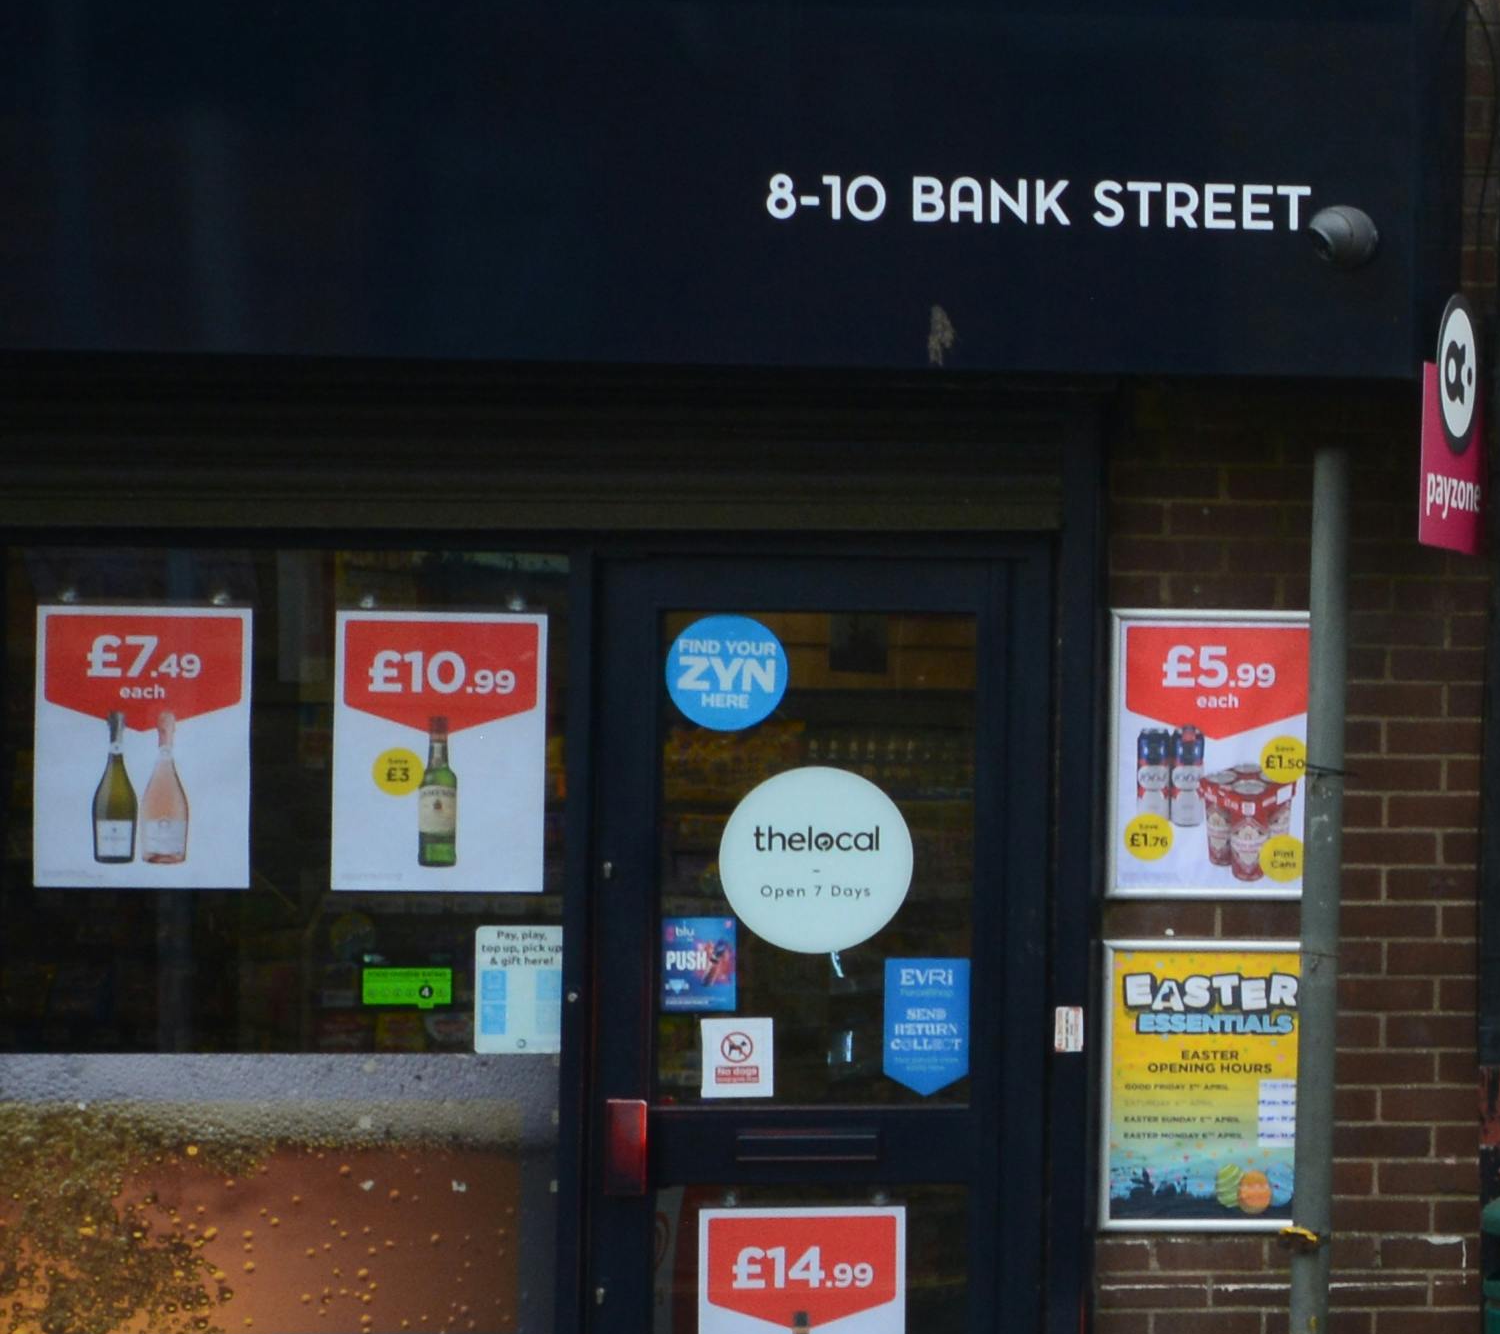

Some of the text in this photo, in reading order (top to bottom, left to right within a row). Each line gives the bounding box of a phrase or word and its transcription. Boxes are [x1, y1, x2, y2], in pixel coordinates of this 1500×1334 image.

[767, 173, 1312, 232] 8-10 BANK STREET
[1426, 472, 1481, 520] payzone
[86, 634, 202, 679] £7.49
[679, 639, 777, 657] FIND YOUR
[367, 650, 516, 694] £10.99
[677, 655, 776, 694] ZYN
[1162, 644, 1276, 689] £5.99
[119, 684, 166, 699] each
[701, 693, 749, 709] HERE
[1196, 693, 1239, 709] each
[1265, 754, 1305, 770] £1.50
[386, 767, 410, 783] £3
[753, 825, 880, 852] thelocal
[1130, 832, 1169, 848] £1.76
[760, 884, 872, 900] Open 7 Days
[665, 950, 707, 971] PUSH
[421, 986, 431, 998] 4
[1124, 973, 1299, 1012] EASTER
[906, 1007, 947, 1021] SEND
[1137, 1013, 1294, 1035] ESSENTIALS
[1181, 1050, 1239, 1061] EASTER
[717, 1067, 758, 1078] No dogs
[1147, 1062, 1273, 1074] OPENING HOURS
[732, 1246, 874, 1290] £14.99
